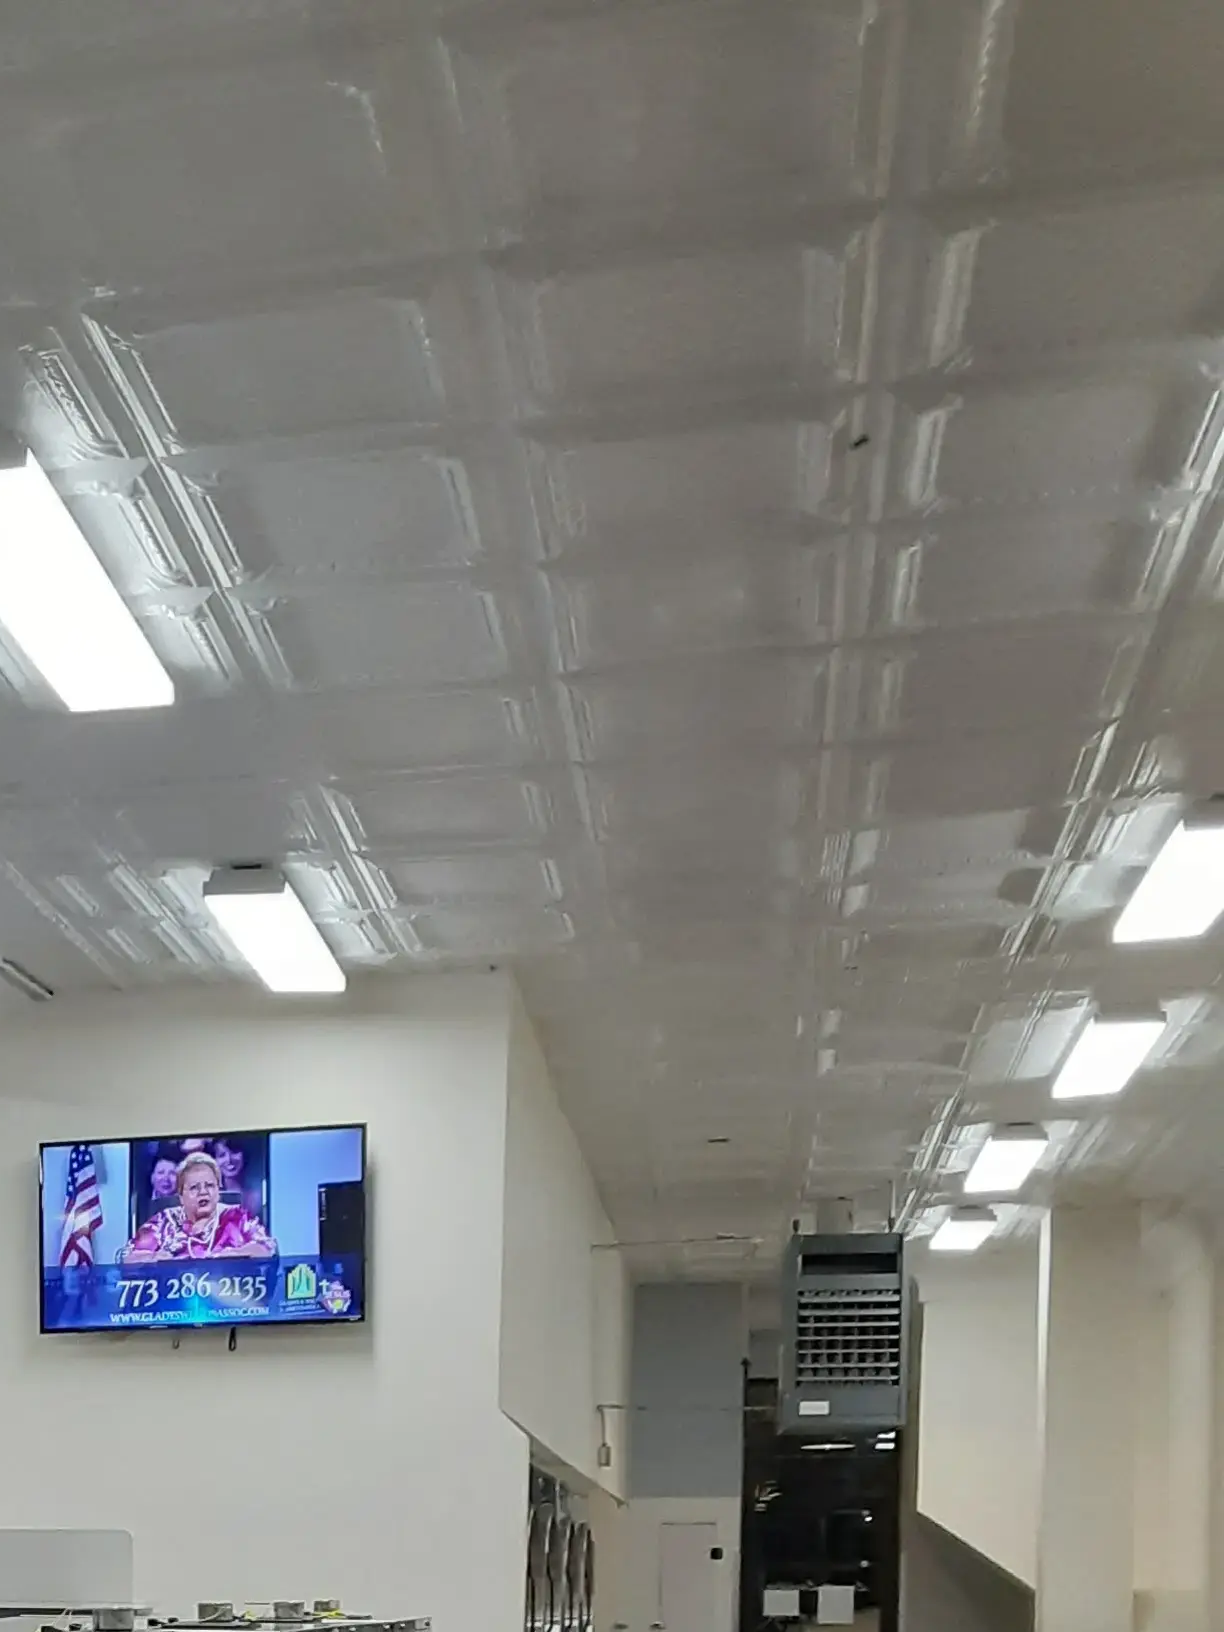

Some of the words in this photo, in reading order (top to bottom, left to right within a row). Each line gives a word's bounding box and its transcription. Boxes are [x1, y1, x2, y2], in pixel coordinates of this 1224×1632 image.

[115, 1279, 159, 1308] 773
[166, 1272, 212, 1299] 286
[218, 1276, 267, 1302] 2135
